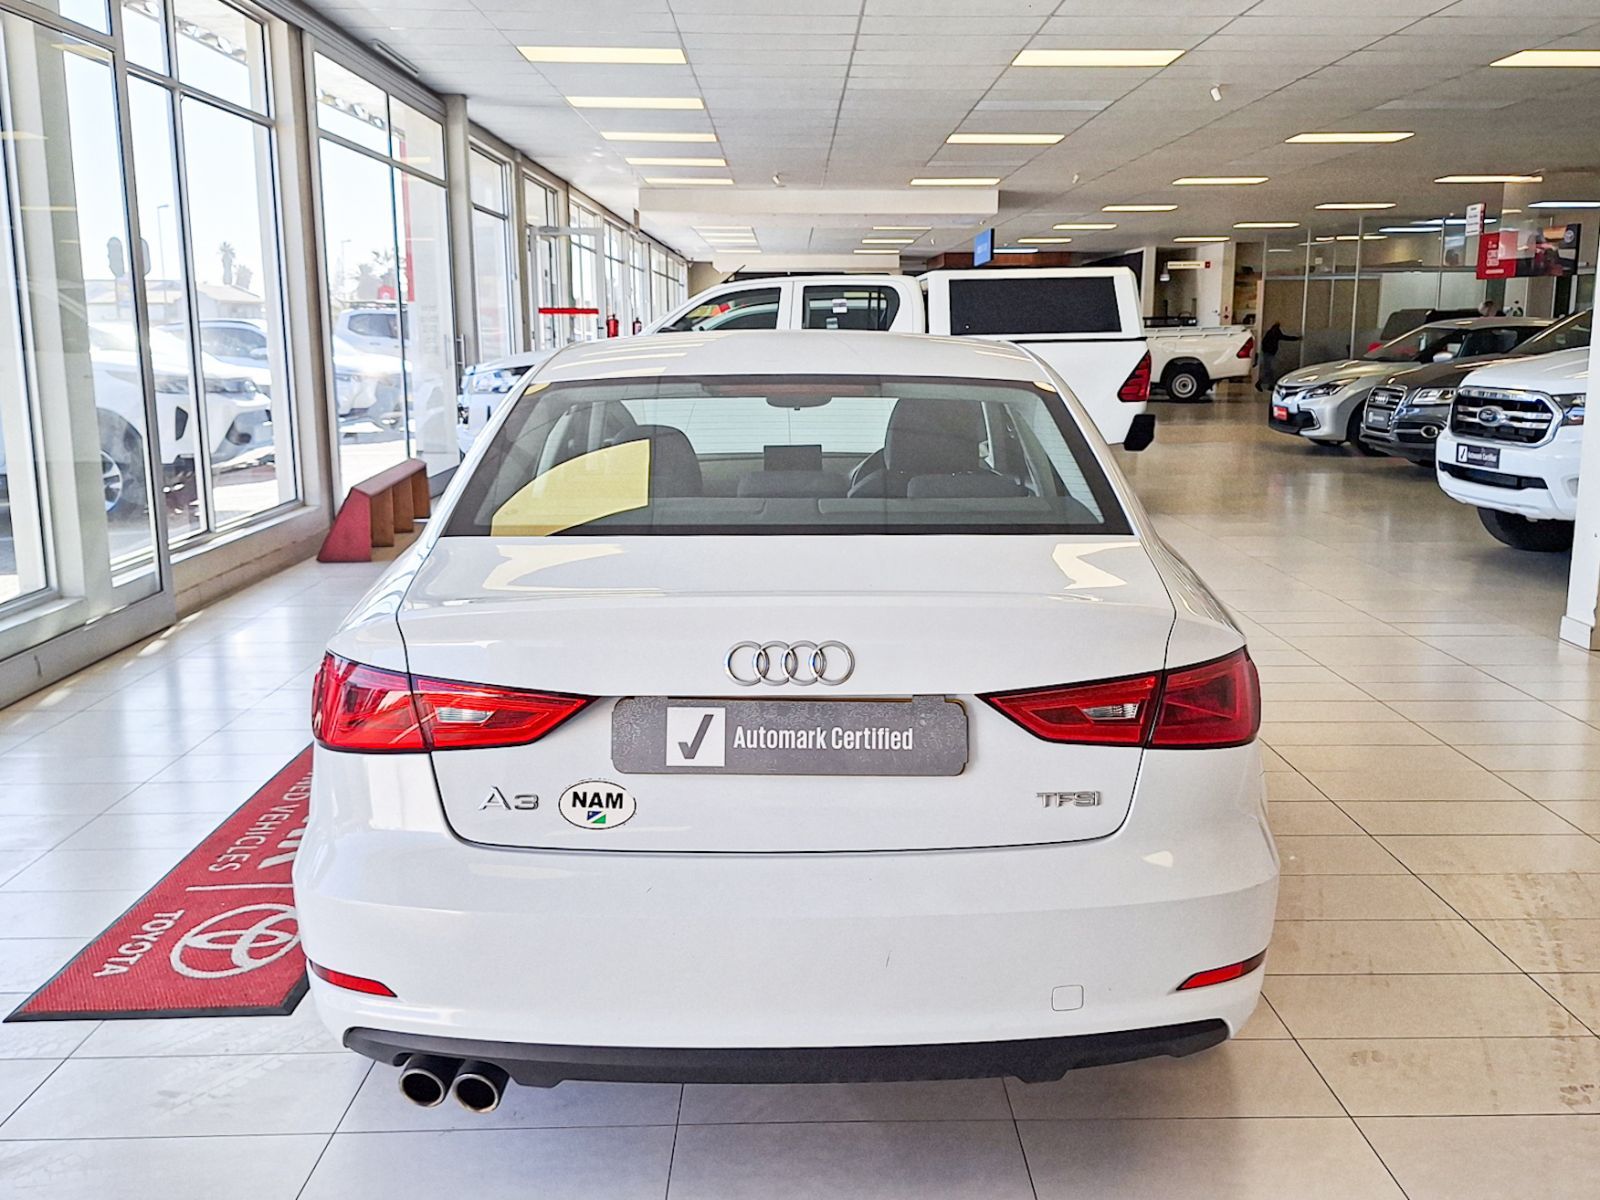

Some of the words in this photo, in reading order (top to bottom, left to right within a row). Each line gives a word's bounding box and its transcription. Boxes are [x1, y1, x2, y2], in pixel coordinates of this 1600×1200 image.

[733, 726, 828, 749] Automark
[831, 727, 914, 750] Certified
[478, 785, 540, 811] A3
[571, 791, 624, 809] NAM
[1036, 791, 1102, 807] TFSI
[207, 803, 300, 872] VEHICLES
[93, 909, 185, 977] TOYOTA
